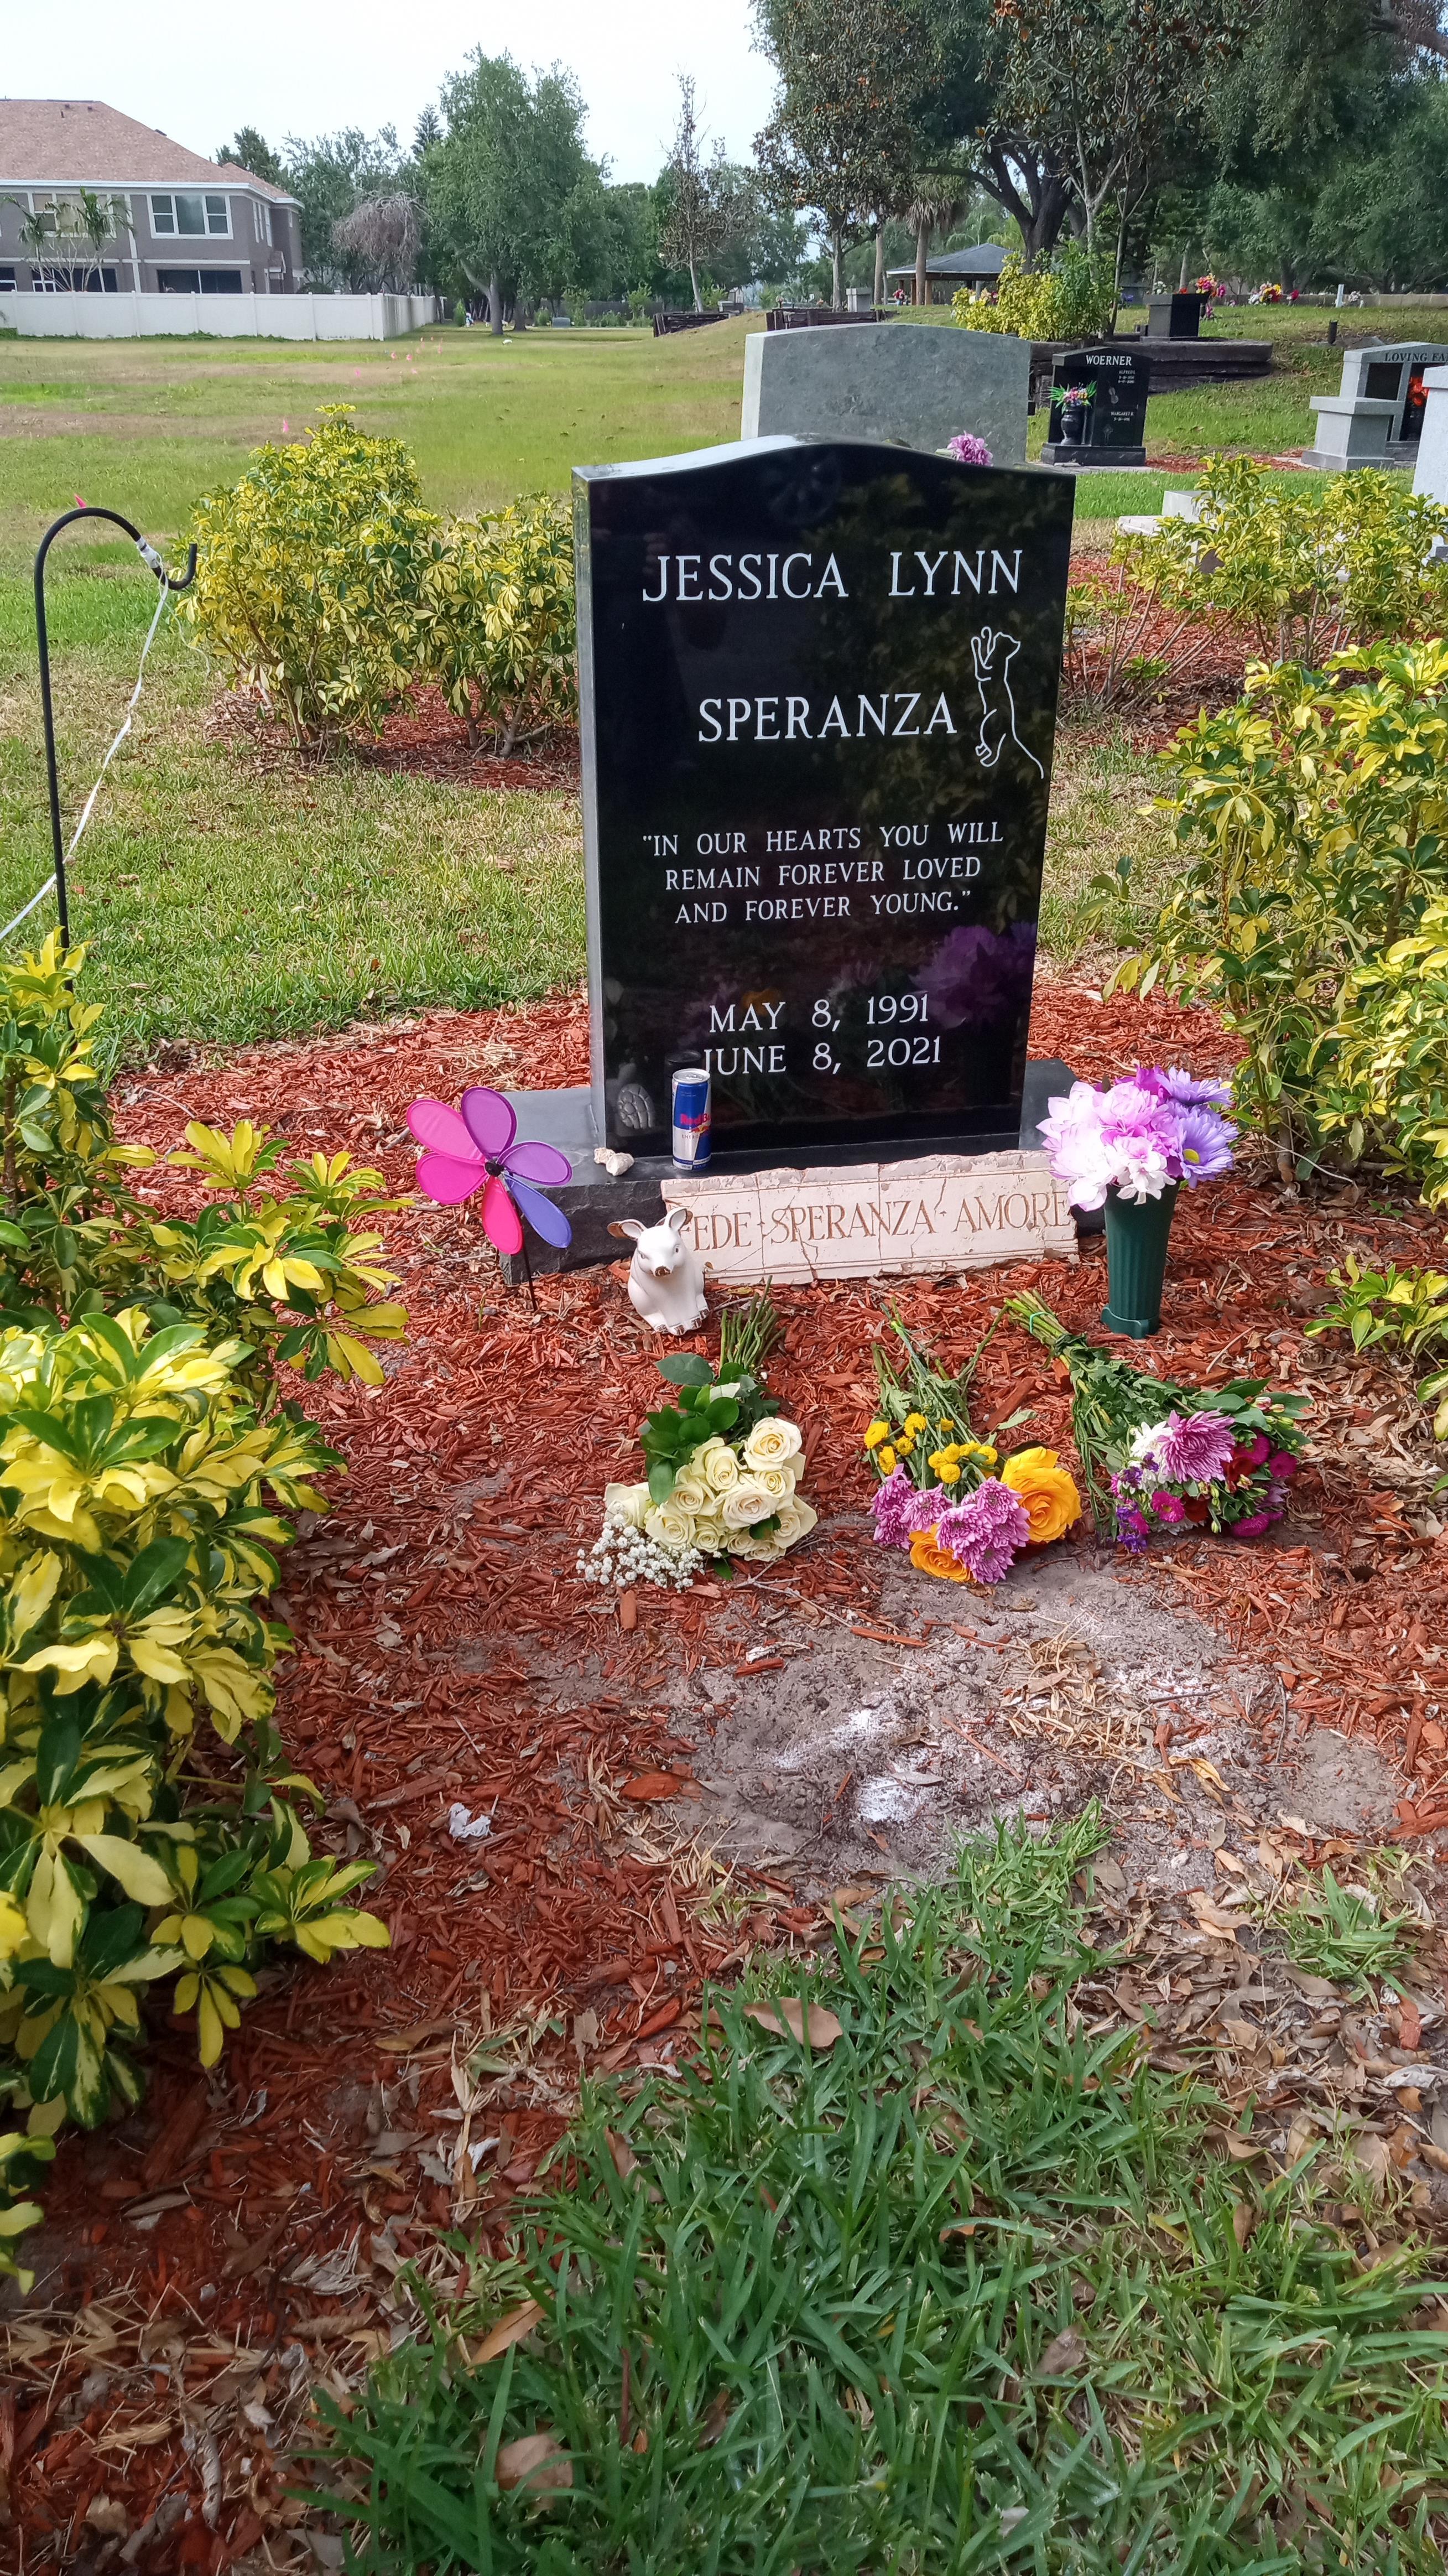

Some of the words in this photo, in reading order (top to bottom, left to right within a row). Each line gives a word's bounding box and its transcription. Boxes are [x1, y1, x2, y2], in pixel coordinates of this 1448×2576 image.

[1085, 355, 1132, 366] WOERNER
[1384, 353, 1427, 362] LOVING
[643, 552, 849, 601] JESSICA
[888, 549, 1023, 596] LYNN
[699, 692, 957, 742] SPERANZA
[697, 832, 747, 855] OUR
[766, 828, 861, 851] HEARTS
[879, 824, 929, 847] YOU
[947, 822, 1003, 843] WILL
[665, 866, 761, 890] REMAIN
[778, 861, 884, 886] FOREVER
[903, 856, 981, 880] LOVED
[674, 902, 727, 923] AND
[745, 896, 851, 921] FOREVER
[709, 1001, 786, 1033] MAY
[811, 999, 841, 1032] 8,
[867, 994, 929, 1025] 1991
[704, 1045, 786, 1075] JUNE
[812, 1042, 841, 1074] 8,
[867, 1036, 940, 1067] 2021
[771, 1199, 937, 1244] SPERANZA
[952, 1190, 1071, 1233] AMORE
